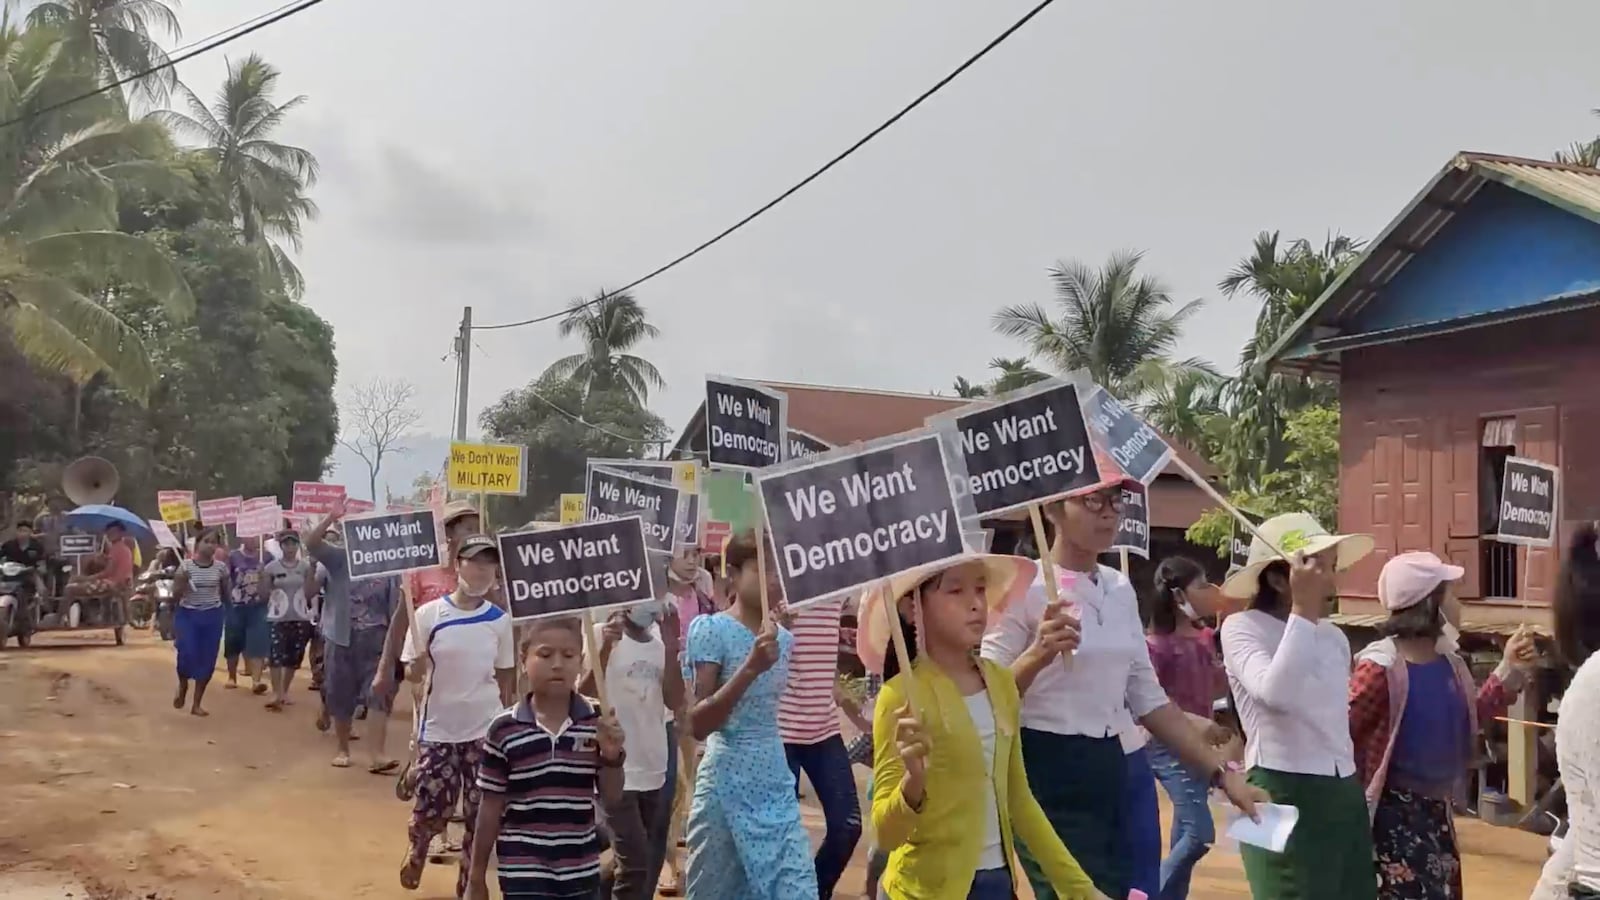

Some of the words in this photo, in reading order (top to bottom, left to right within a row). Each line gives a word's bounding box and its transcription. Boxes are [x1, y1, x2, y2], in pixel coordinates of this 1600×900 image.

[717, 392, 743, 418] We
[746, 398, 772, 426] Want
[993, 406, 1058, 446] Want
[451, 448, 466, 464] We
[468, 450, 493, 465] Don't
[496, 452, 519, 467] Want
[711, 425, 780, 464] Democracy
[1111, 423, 1154, 467] Democ
[457, 470, 512, 488] MILITARY
[950, 445, 1086, 500] Democracy
[1511, 472, 1528, 493] We
[1531, 475, 1549, 497] Want
[599, 480, 620, 502] We
[624, 486, 662, 511] Want
[785, 483, 836, 522] We
[842, 461, 917, 508] Want
[355, 523, 381, 542] We
[383, 519, 422, 538] Want
[590, 505, 670, 542] Demacy
[1503, 501, 1552, 530] Democracy
[352, 542, 435, 566] Democracy
[517, 541, 555, 567] We
[560, 533, 621, 561] Want
[783, 508, 950, 579] Democracy
[512, 566, 643, 602] Democracy
